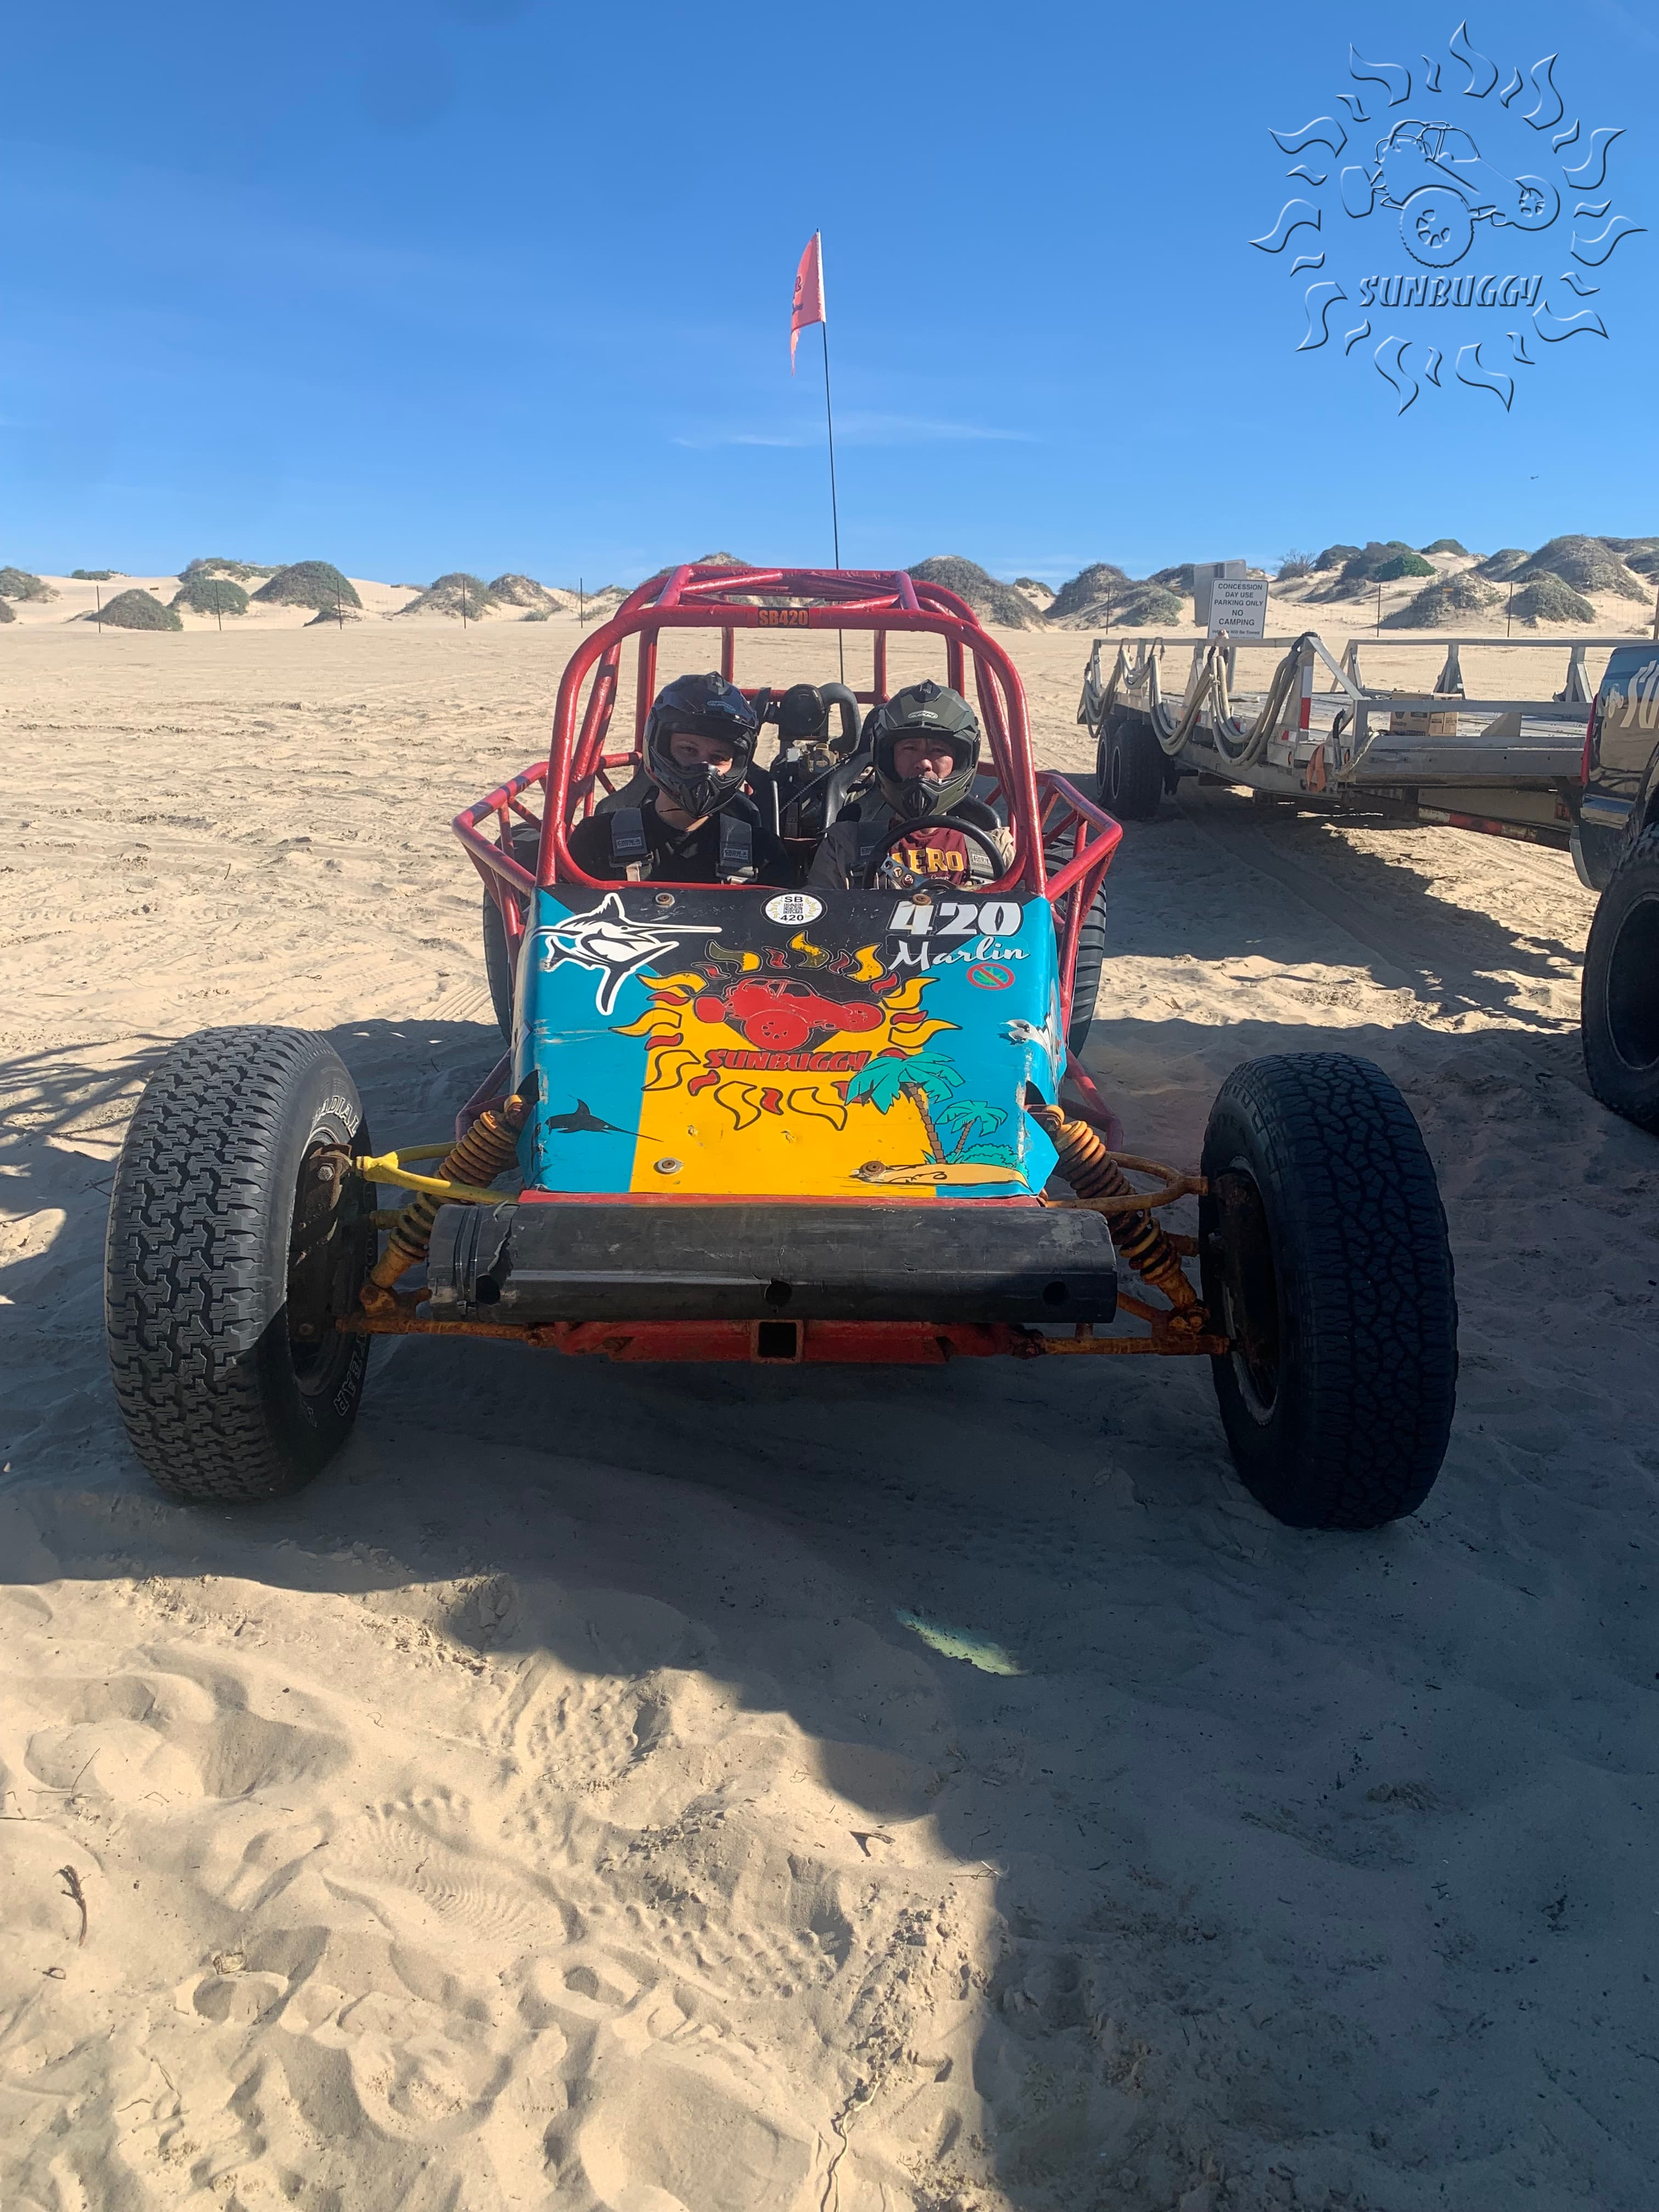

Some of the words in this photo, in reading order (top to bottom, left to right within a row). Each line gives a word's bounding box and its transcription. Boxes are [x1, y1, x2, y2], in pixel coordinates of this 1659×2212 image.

[759, 610, 808, 625] SB420
[1620, 659, 1659, 729] SU
[889, 901, 1022, 936] 420
[888, 936, 1030, 971] Marlin
[704, 1049, 871, 1071] SUNBUGGY
